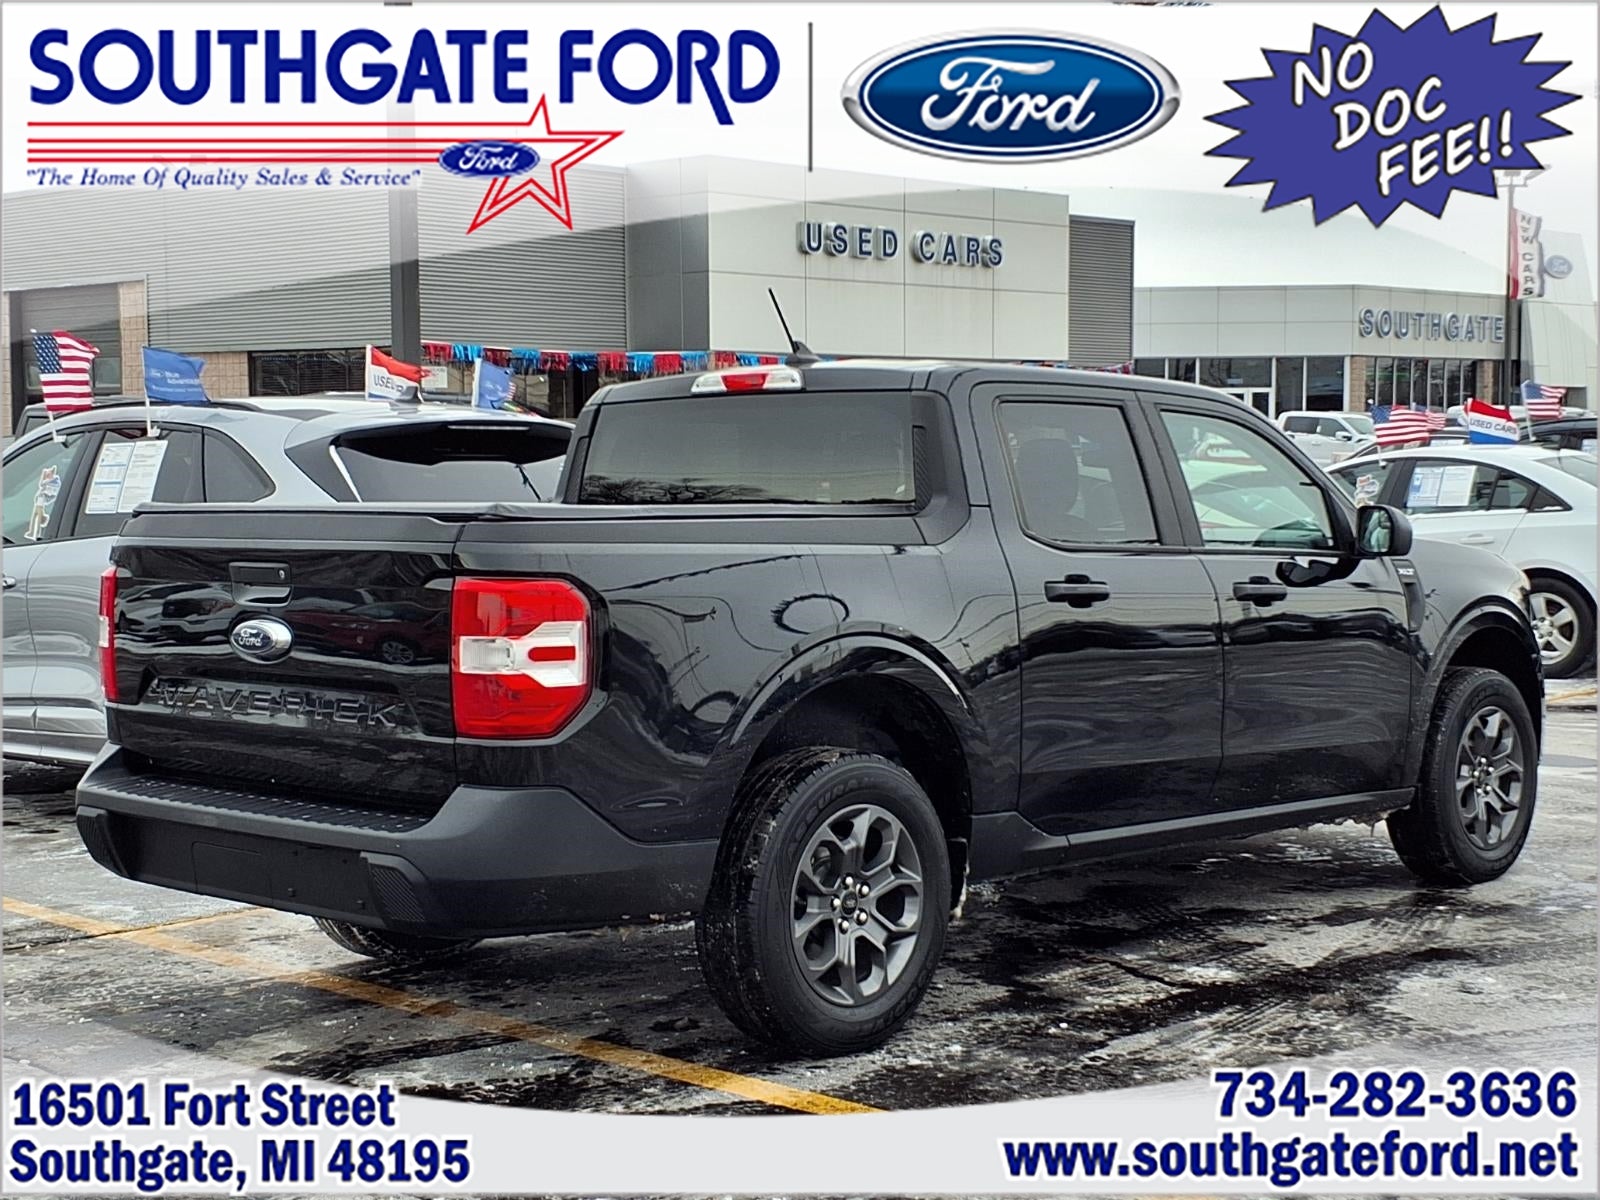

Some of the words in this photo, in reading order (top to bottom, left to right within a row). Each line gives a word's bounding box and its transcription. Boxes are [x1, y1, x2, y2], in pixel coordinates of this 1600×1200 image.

[801, 221, 898, 259] USED
[914, 231, 1004, 268] CARS
[1522, 252, 1535, 296] CARS
[1360, 308, 1504, 343] SOUTHGATE
[1470, 418, 1492, 430] USED
[238, 627, 264, 647] Ford
